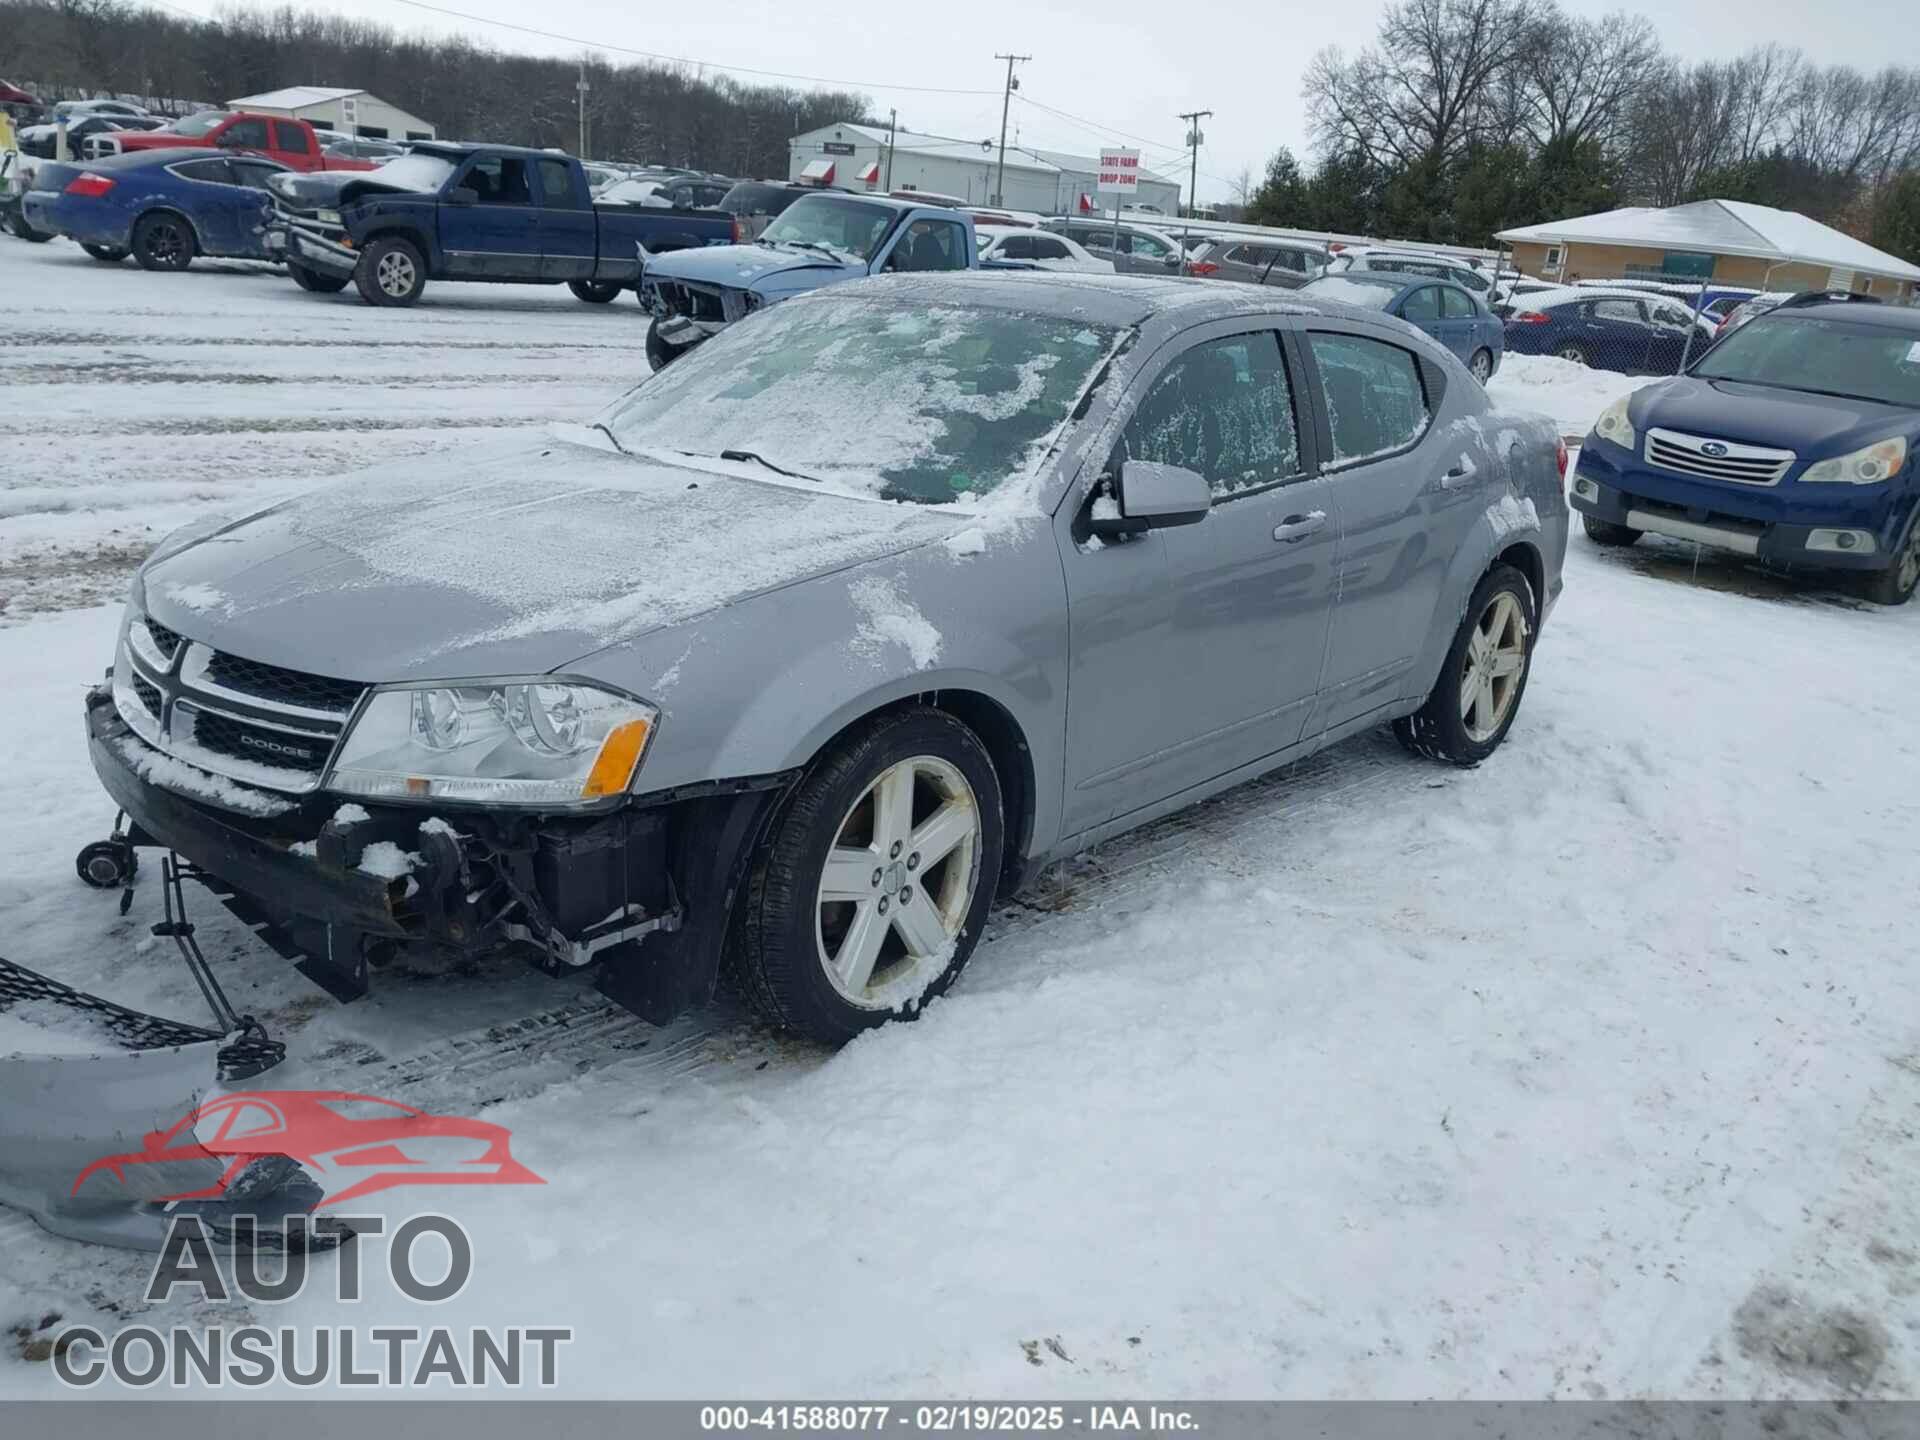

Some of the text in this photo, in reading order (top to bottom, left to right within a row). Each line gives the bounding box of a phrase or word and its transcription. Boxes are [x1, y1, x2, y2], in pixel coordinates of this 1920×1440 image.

[1100, 156, 1138, 168] STATE FARM
[1100, 173, 1136, 185] DROP ZONE
[241, 736, 313, 759] DODGE
